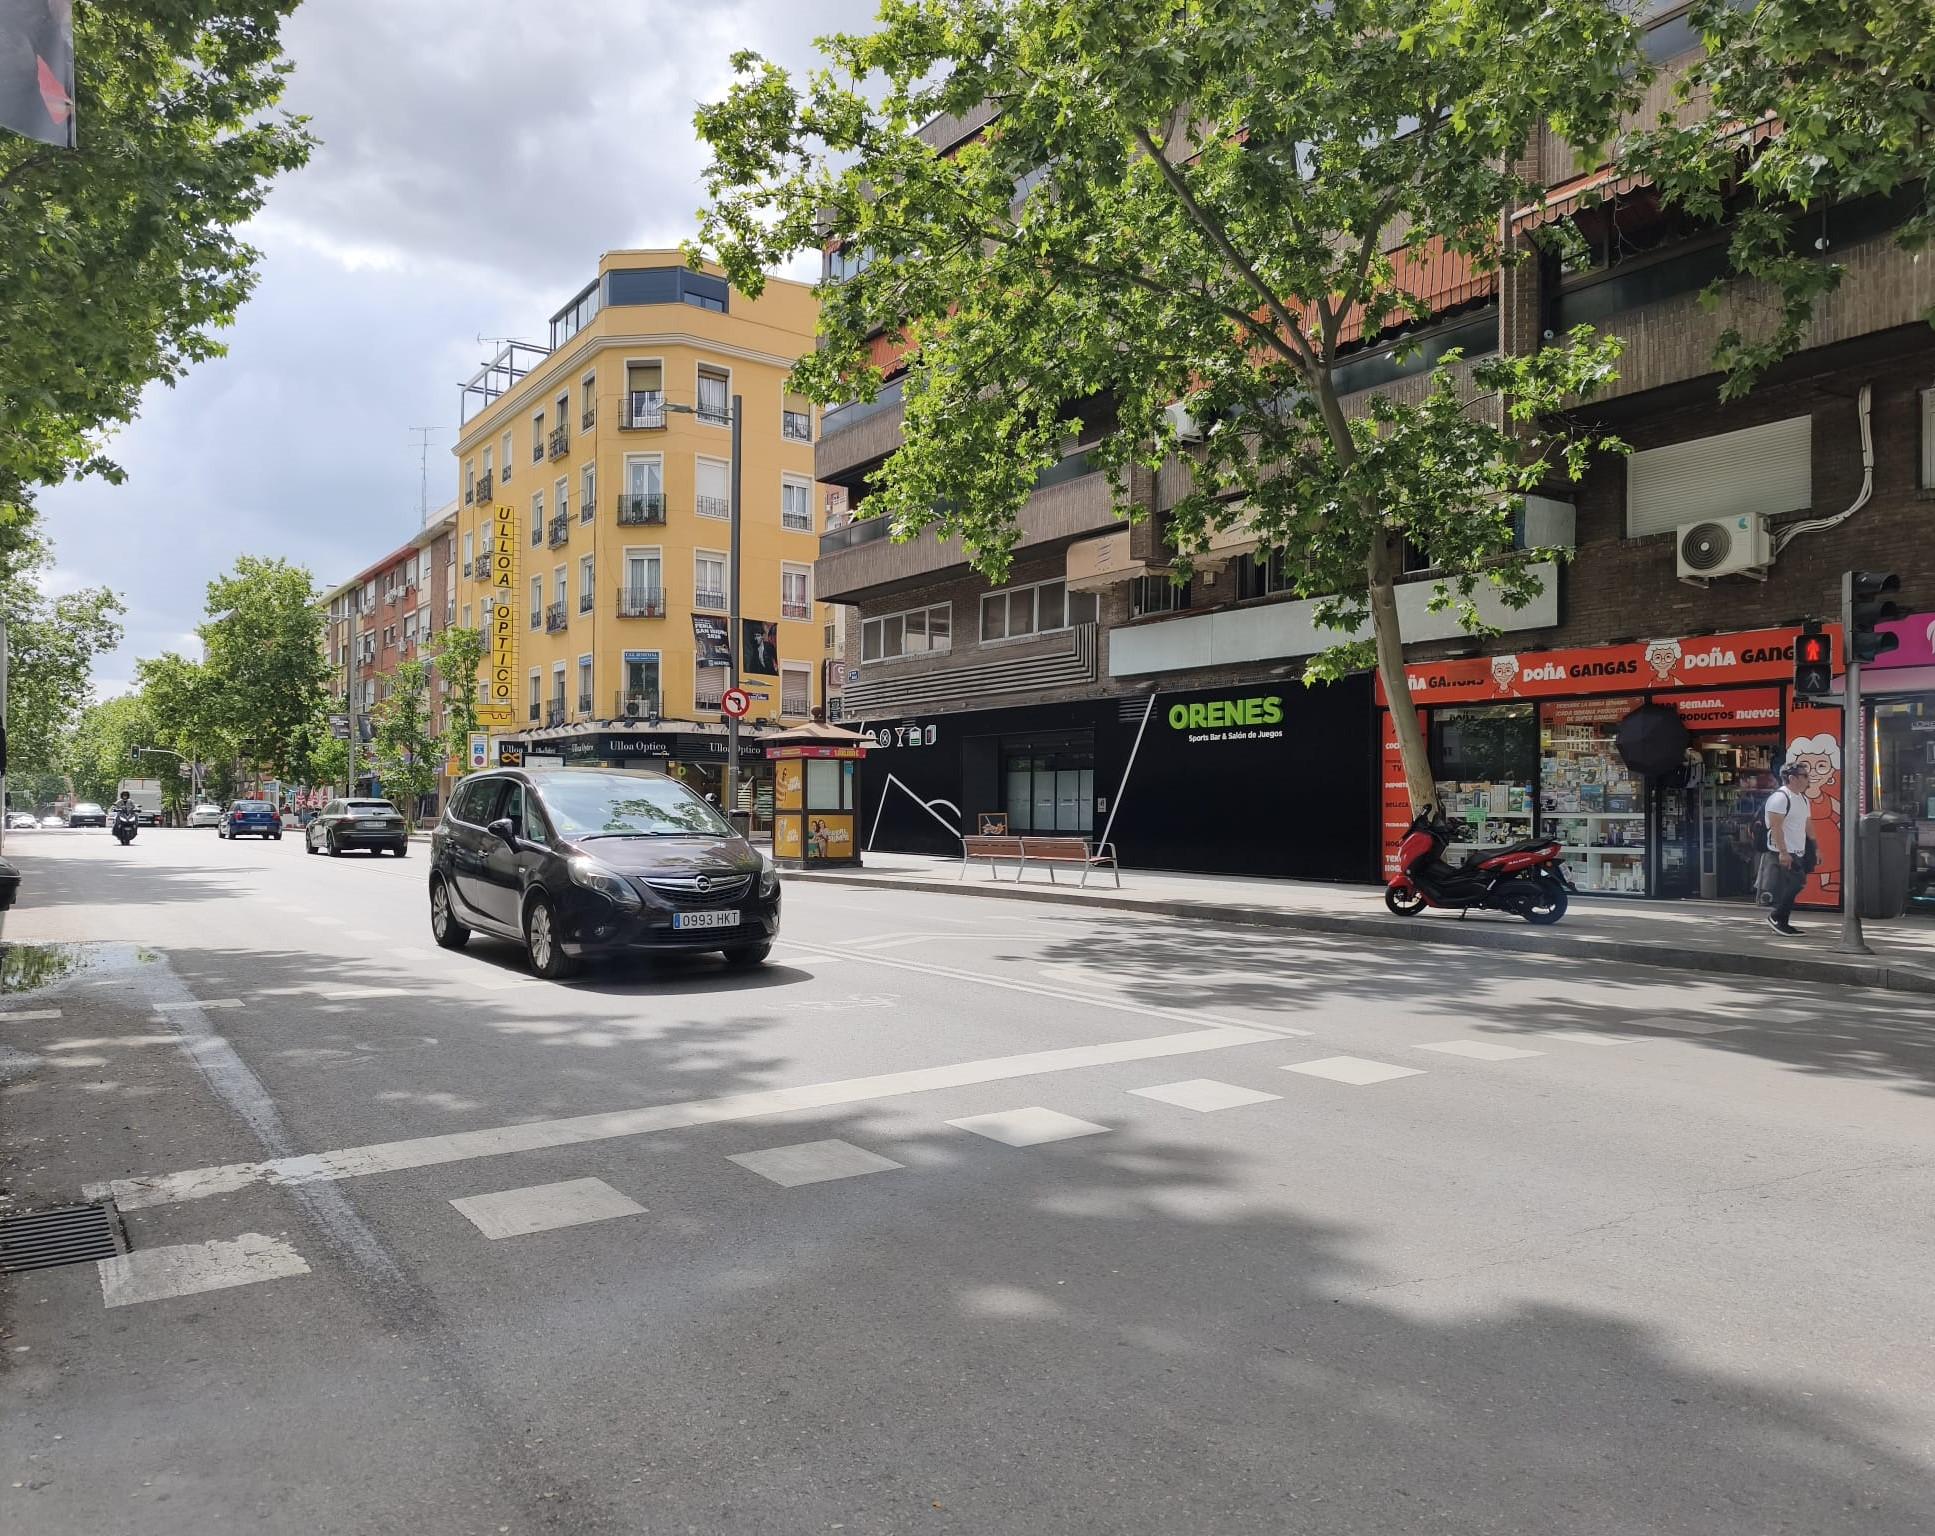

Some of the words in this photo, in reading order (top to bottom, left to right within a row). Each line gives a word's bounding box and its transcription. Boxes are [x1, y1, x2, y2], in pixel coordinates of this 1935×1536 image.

[498, 507, 511, 586] ULLOA
[496, 606, 511, 698] OPTICO
[1684, 647, 1736, 670] DOÑA
[1740, 645, 1795, 664] GANG
[1522, 663, 1566, 682] DOÑA
[1569, 660, 1638, 678] GANGAS
[1407, 674, 1427, 691] ÑA
[1168, 696, 1283, 730] ORENES
[1680, 711, 1735, 722] RODUCTOS
[1188, 734, 1209, 743] Sports
[1228, 731, 1247, 740] Salón
[1247, 731, 1257, 739] de
[1258, 730, 1283, 739] Juegos
[610, 740, 634, 750] Ulloa
[635, 740, 667, 752] Optico
[738, 743, 761, 755] ptico
[682, 913, 713, 926] 0993
[716, 911, 738, 924] HKT
